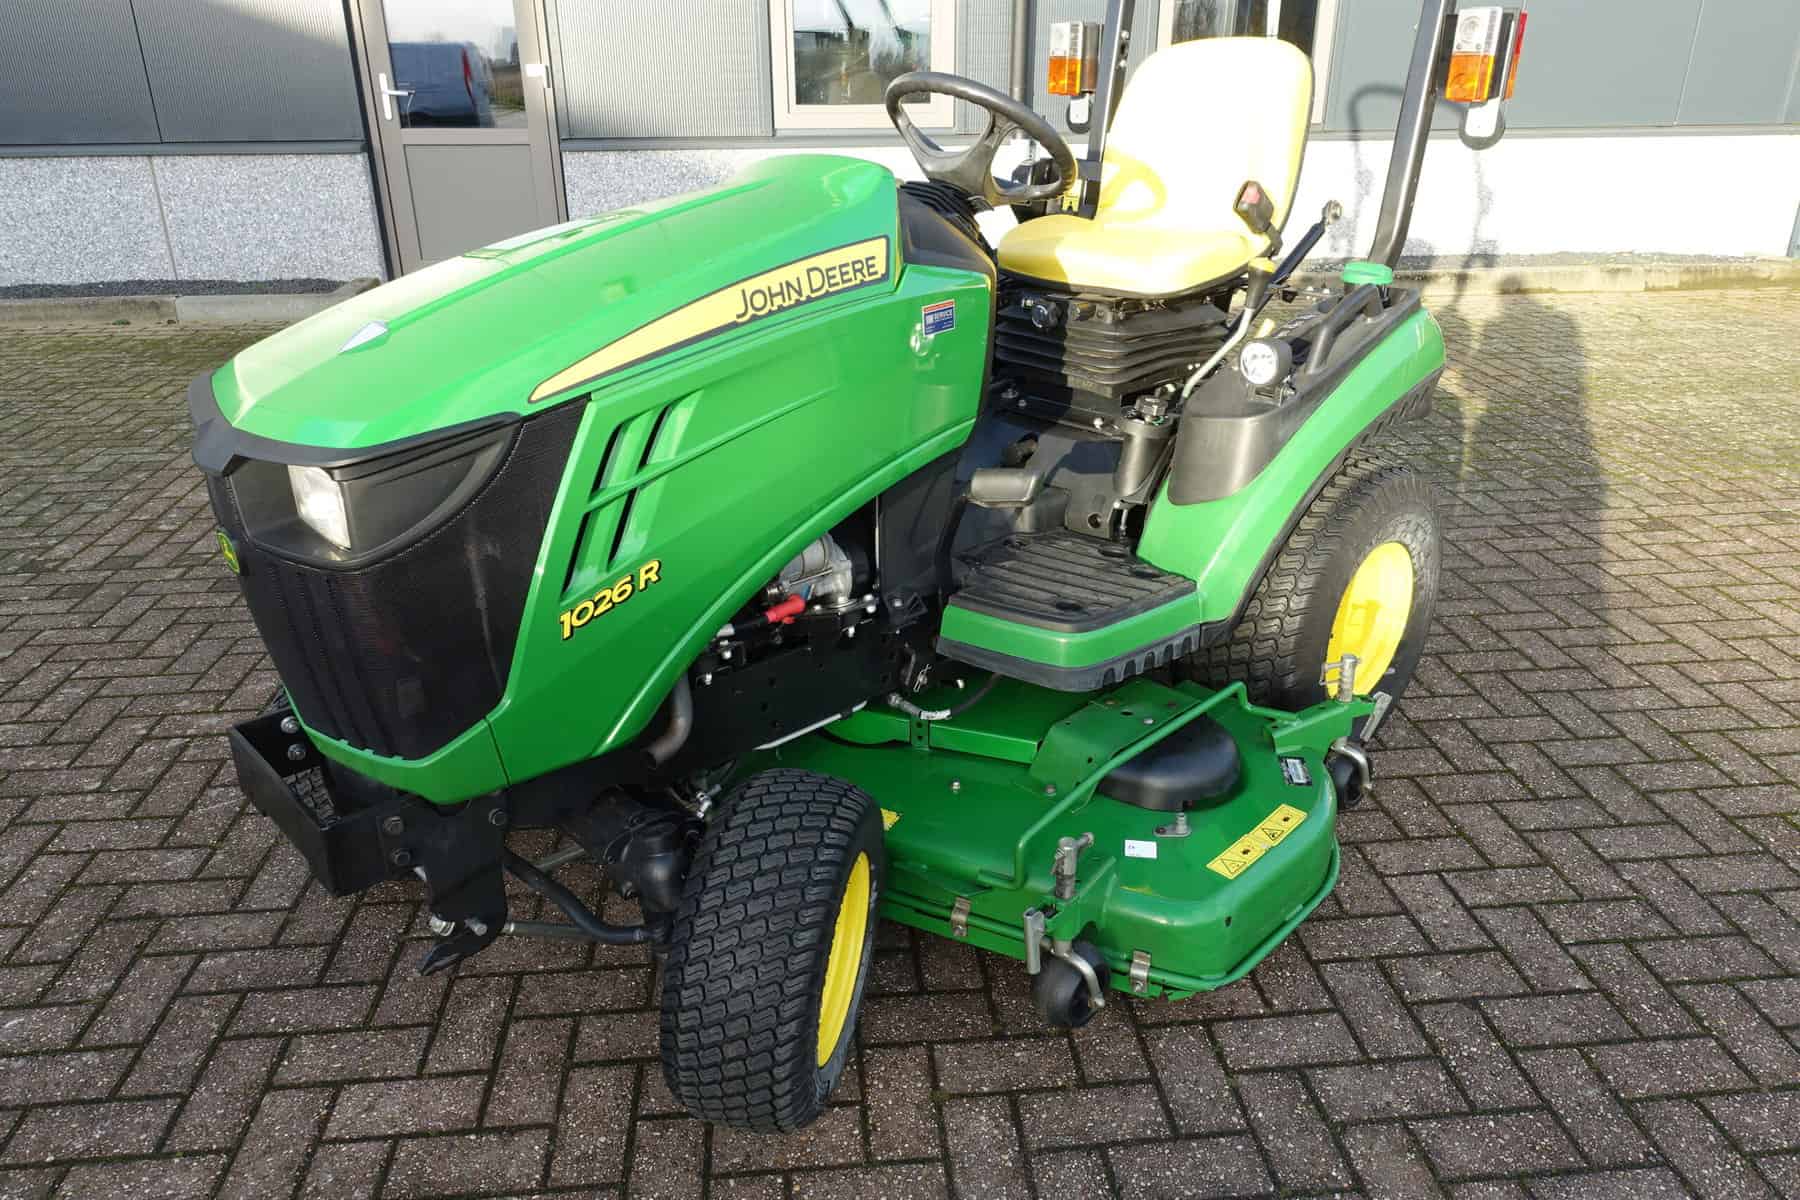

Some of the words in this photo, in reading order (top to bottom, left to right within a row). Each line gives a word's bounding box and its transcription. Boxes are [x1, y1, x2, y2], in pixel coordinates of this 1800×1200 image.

[735, 276, 803, 320] JOHN
[806, 255, 879, 294] DEERE
[560, 574, 634, 640] 1026
[638, 559, 661, 591] R
